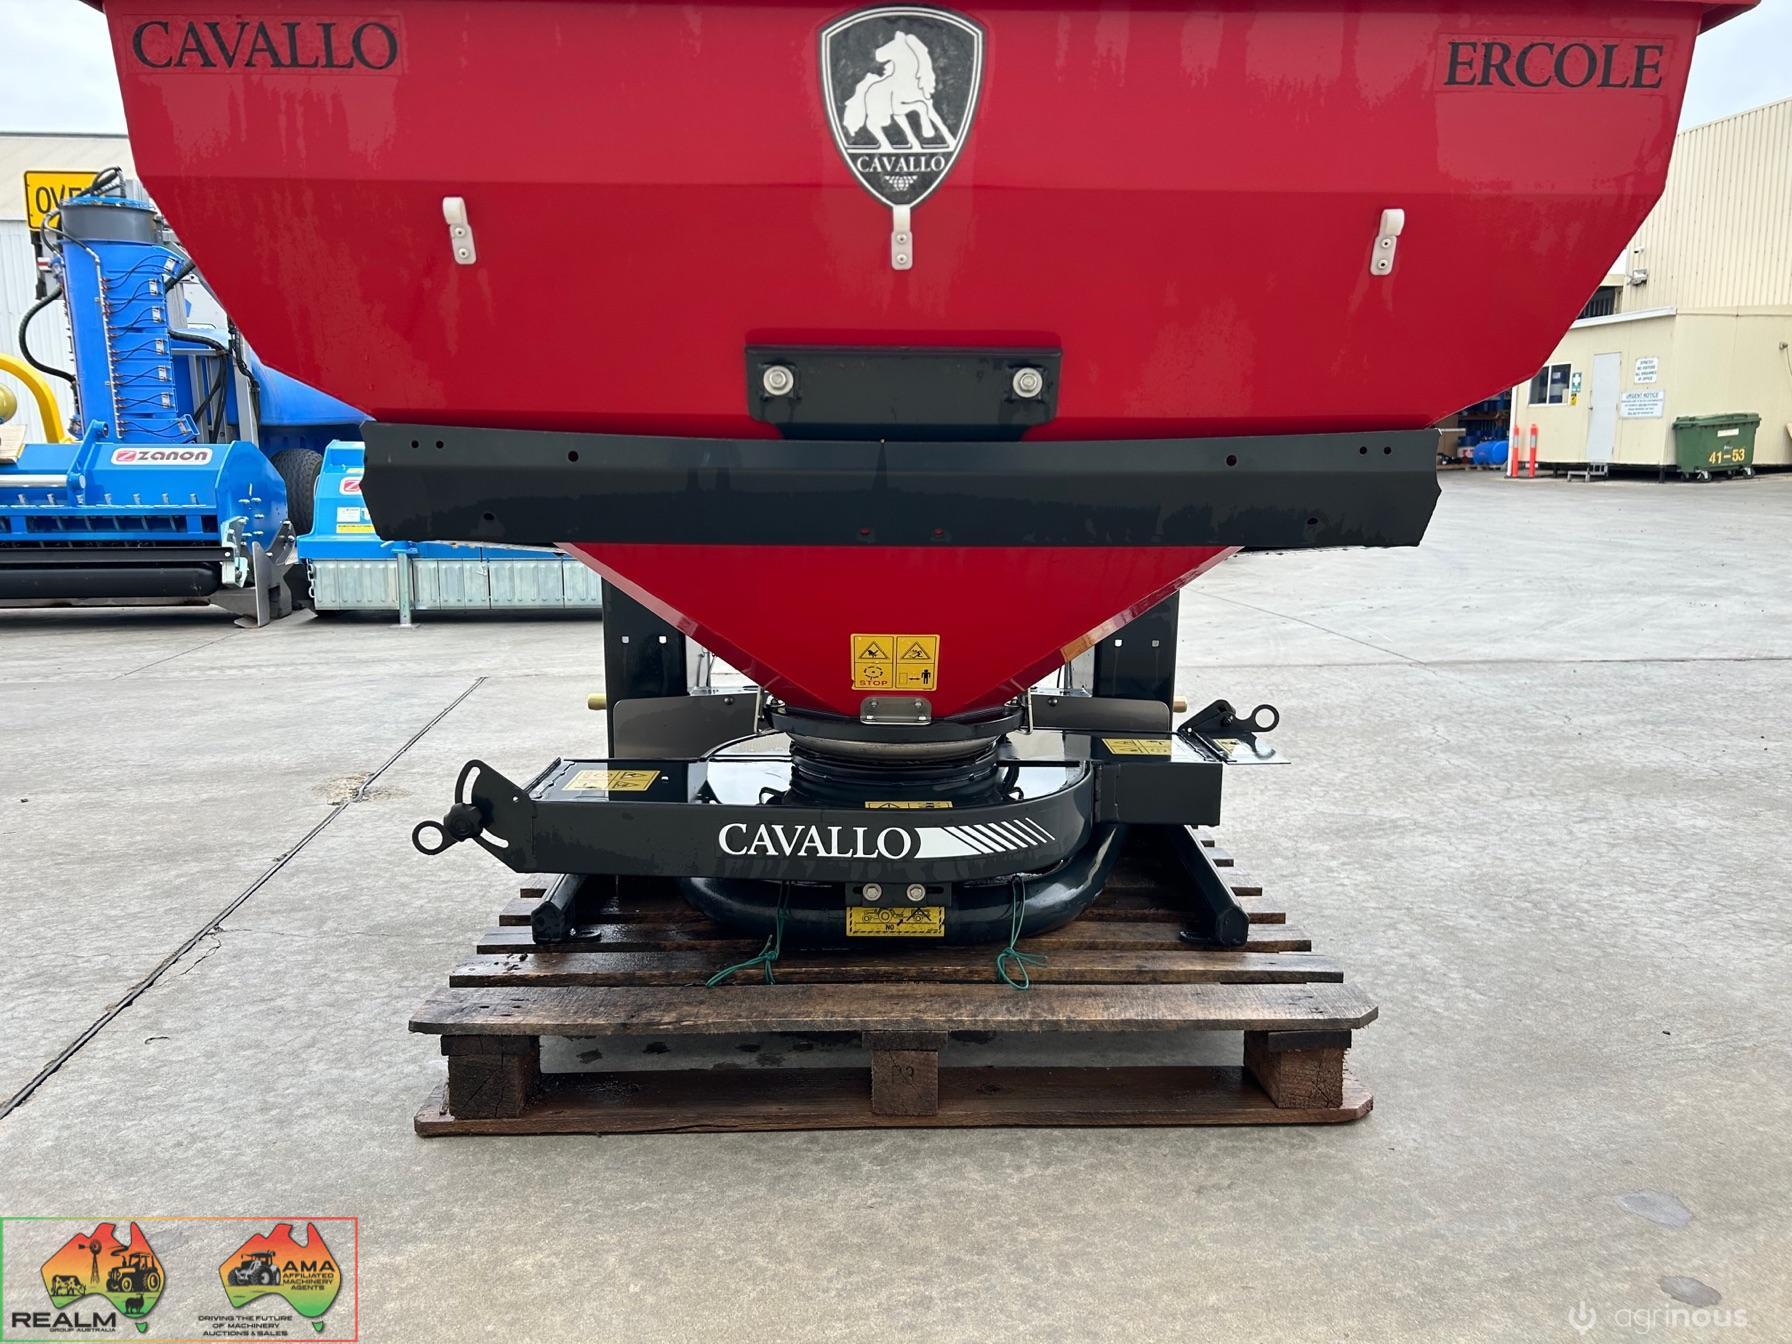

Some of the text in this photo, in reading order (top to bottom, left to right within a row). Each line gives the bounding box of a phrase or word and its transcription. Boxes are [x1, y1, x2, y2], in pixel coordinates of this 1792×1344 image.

[132, 20, 398, 70] CAVALLO
[1444, 40, 1664, 89] ERCOLE
[856, 155, 946, 173] CAVALLO
[1708, 448, 1746, 464] 41-53
[718, 823, 912, 860] CAVALLO
